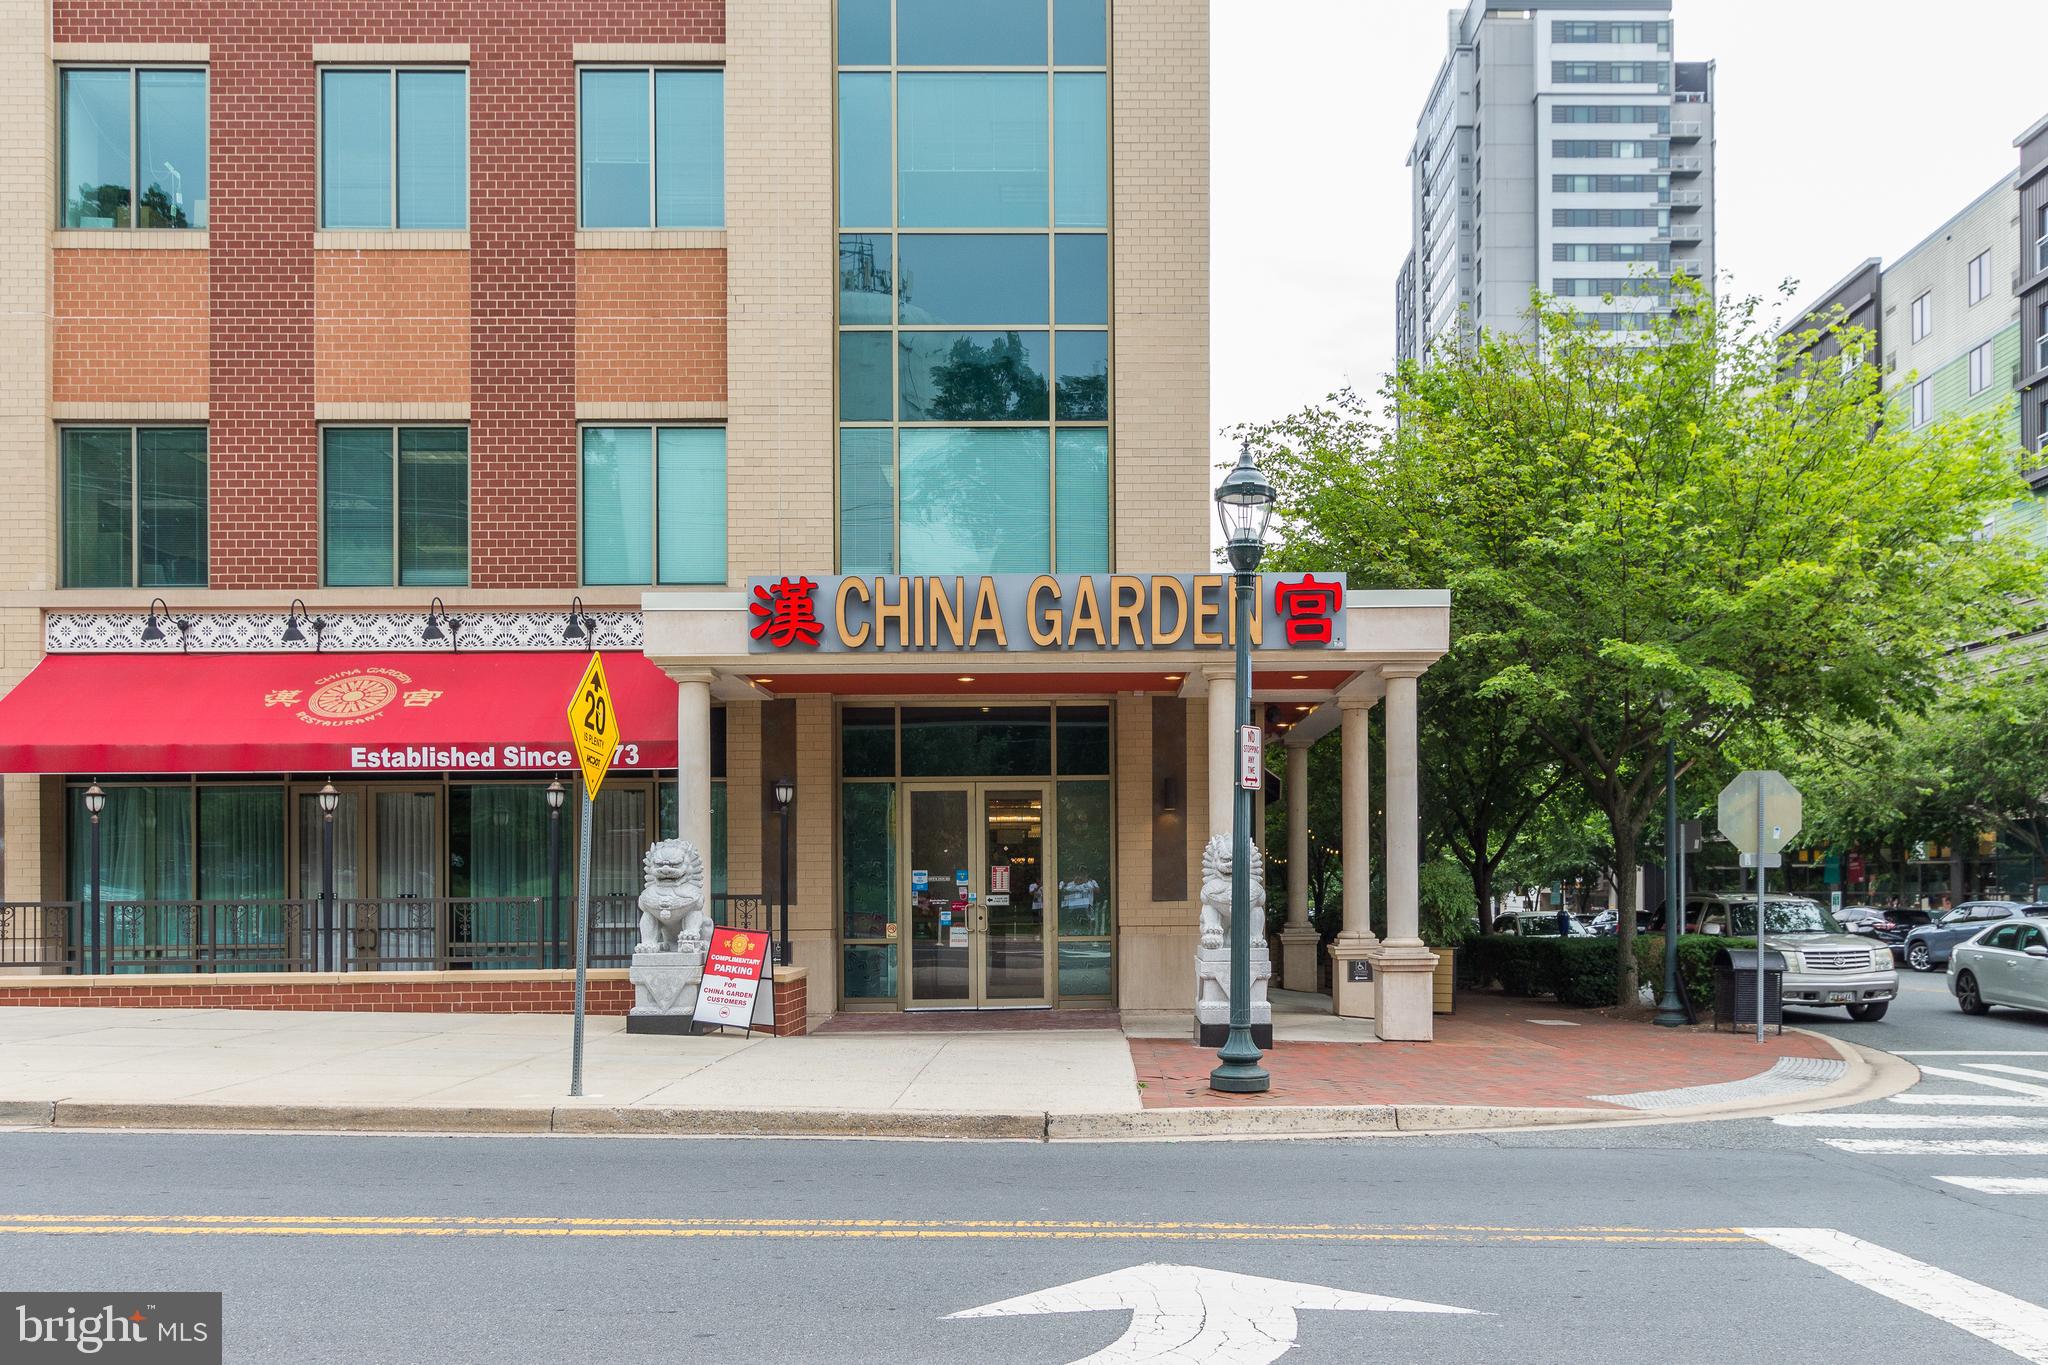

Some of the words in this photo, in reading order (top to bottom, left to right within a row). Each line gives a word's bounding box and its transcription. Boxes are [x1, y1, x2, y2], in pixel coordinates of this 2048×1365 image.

[749, 576, 824, 648] 漢
[834, 575, 1008, 648] CHINA
[1026, 574, 1264, 646] GARDEN
[1275, 573, 1343, 646] 宮
[314, 668, 361, 685] CHINA
[366, 667, 413, 684] GARDEN
[295, 711, 384, 727] RESTAURANT
[584, 690, 606, 735] 20
[588, 734, 605, 749] PLENTY
[1248, 730, 1255, 743] NO
[351, 746, 495, 768] Established
[503, 745, 572, 767] Since
[612, 744, 640, 765] 73
[1244, 745, 1259, 753] STOPPING
[711, 955, 760, 965] COMPLIMENTARY
[714, 964, 752, 975] PARKING
[723, 981, 737, 989] FOR
[703, 987, 725, 996] CHINA
[726, 990, 753, 999] GARDEN
[706, 995, 747, 1006] CUSTOMERS
